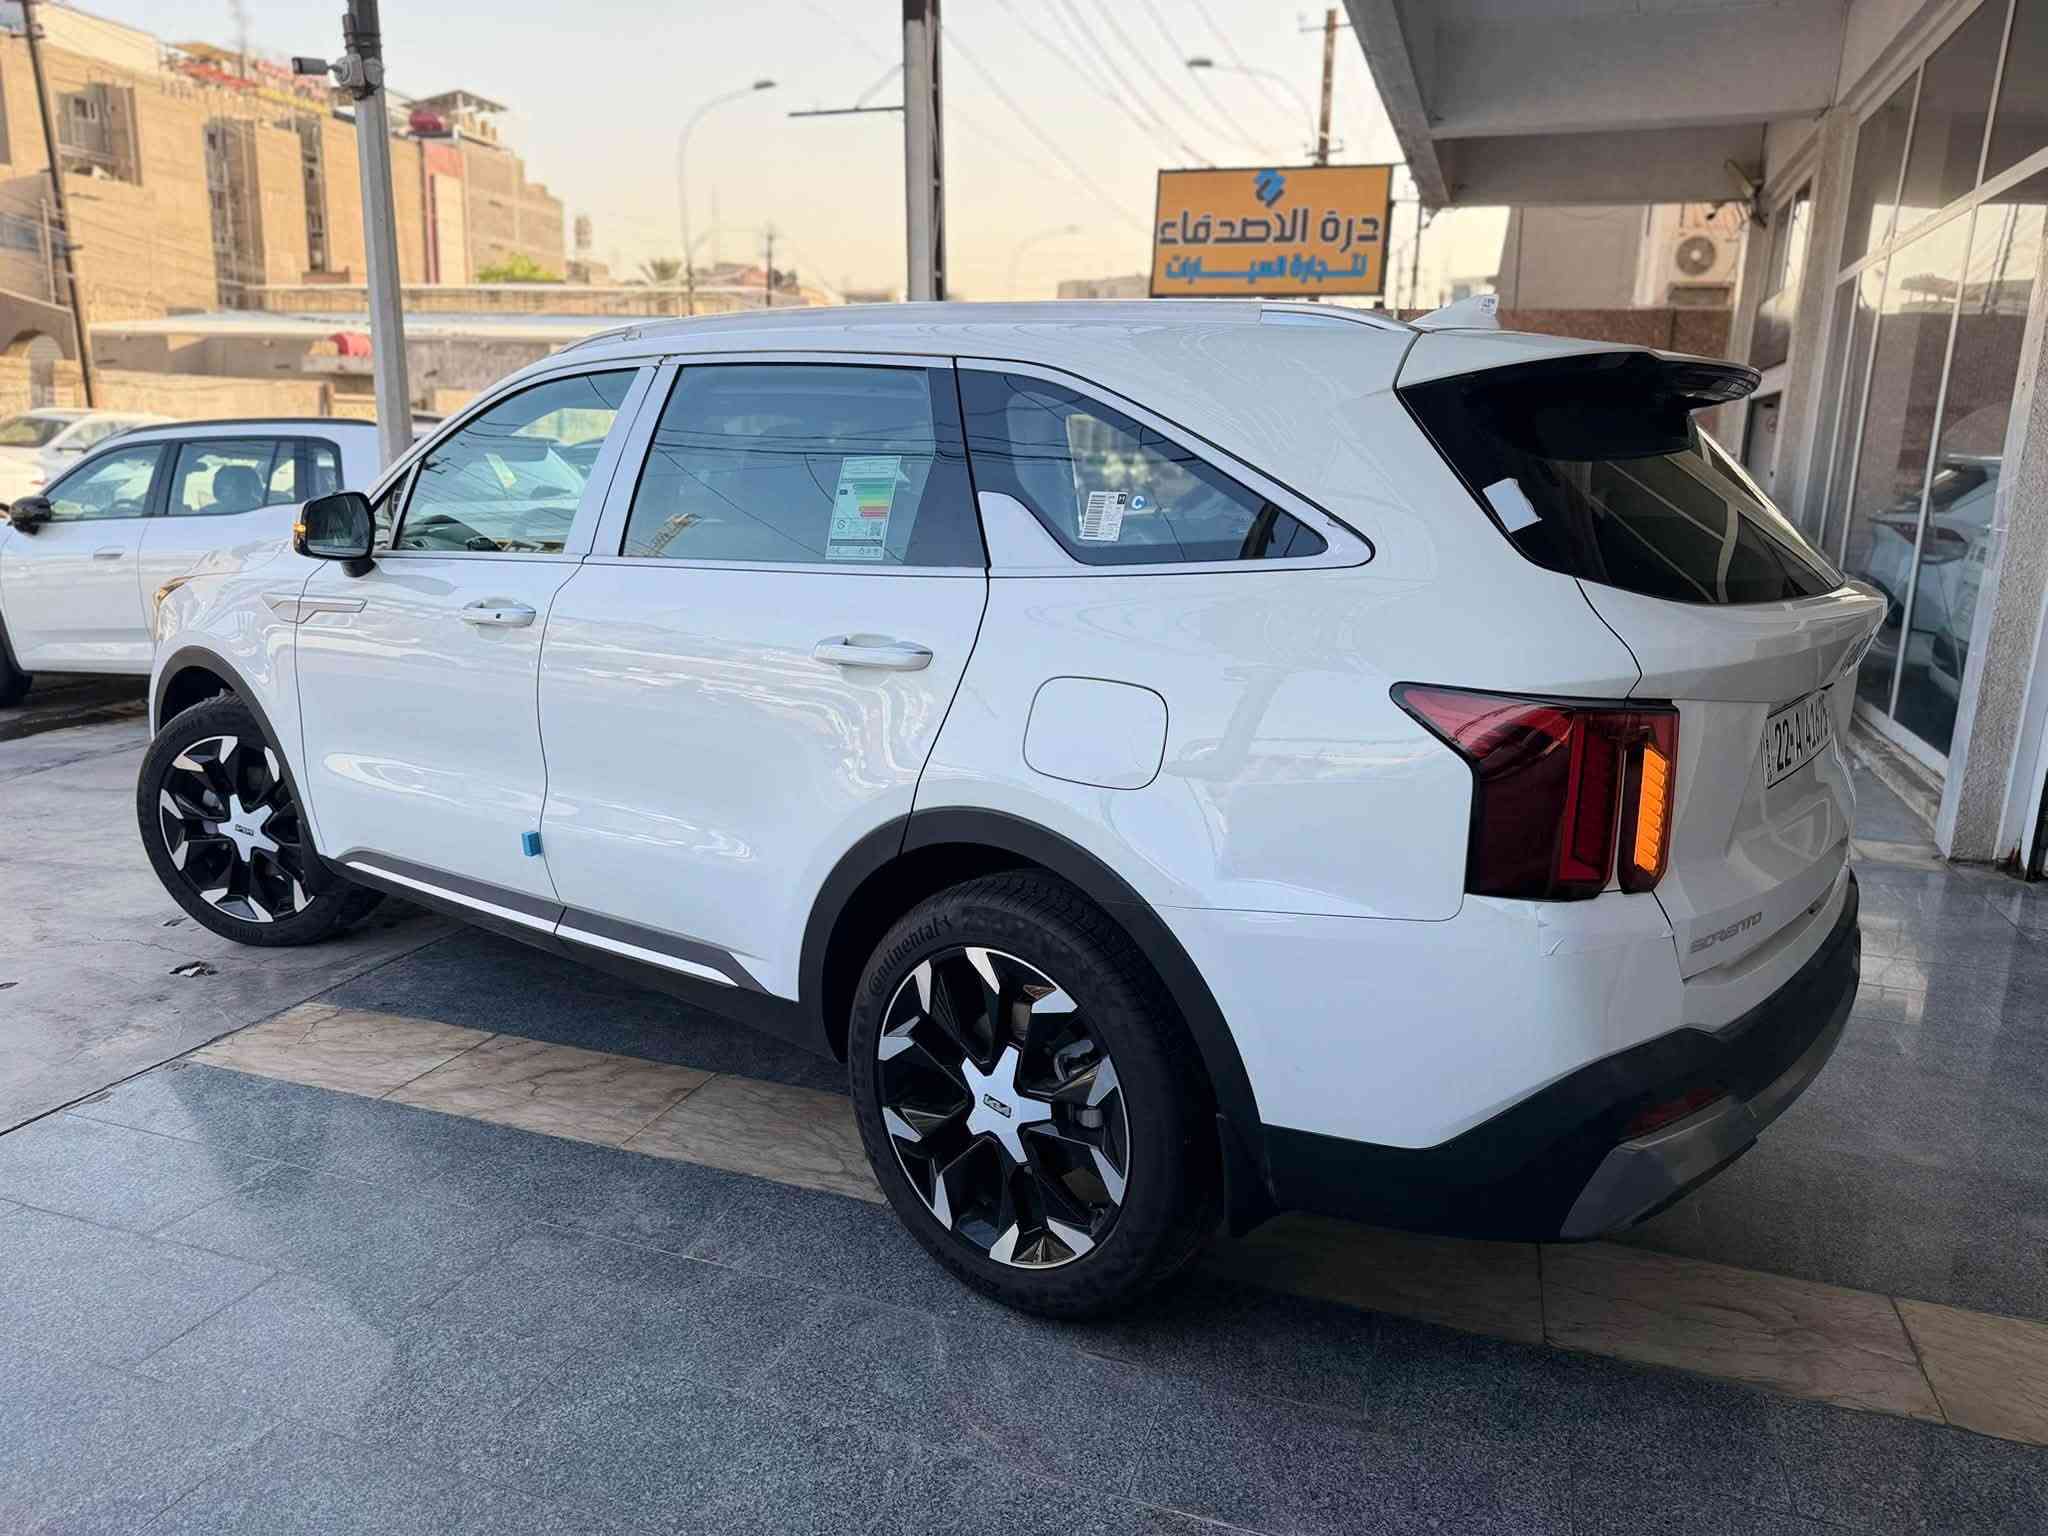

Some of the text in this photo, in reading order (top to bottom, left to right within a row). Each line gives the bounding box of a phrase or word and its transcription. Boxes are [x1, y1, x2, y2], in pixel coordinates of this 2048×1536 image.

[1158, 207, 1380, 253] درة الاصدقاء
[868, 916, 941, 996] Continental
